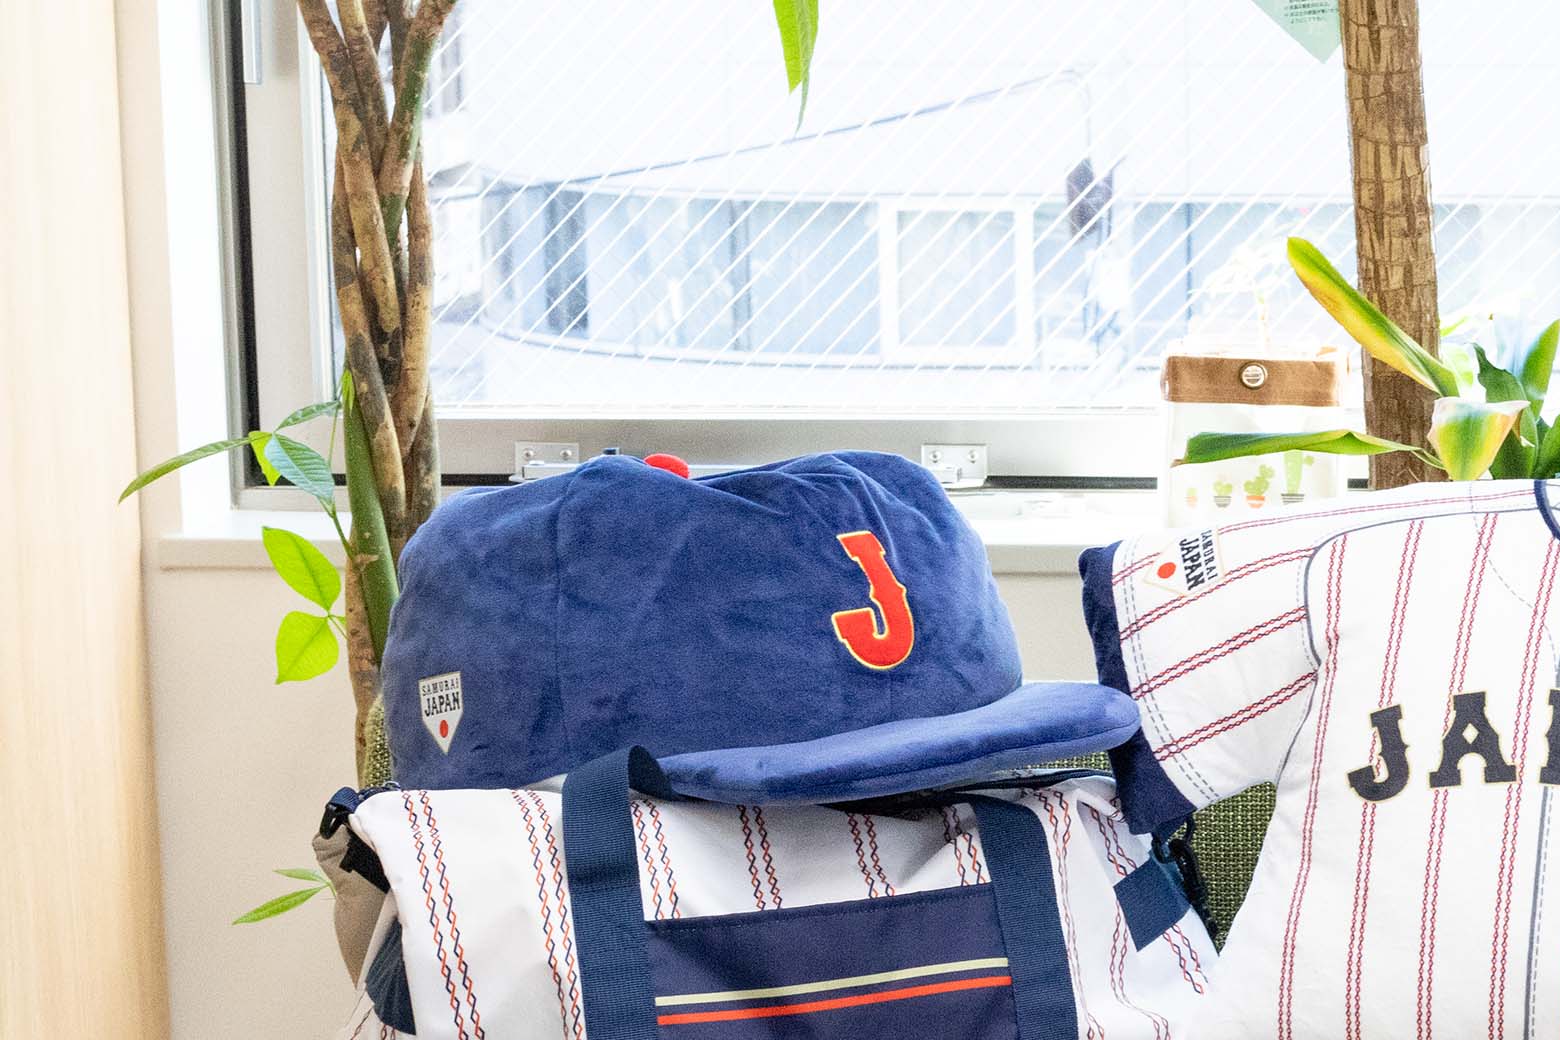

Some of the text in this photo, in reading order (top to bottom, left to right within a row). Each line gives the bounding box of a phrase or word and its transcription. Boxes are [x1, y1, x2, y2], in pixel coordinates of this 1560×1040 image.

[1179, 538, 1206, 592] JAPAN
[831, 530, 916, 670] J
[421, 677, 460, 697] SAMURAI
[424, 691, 461, 717] JAPAN
